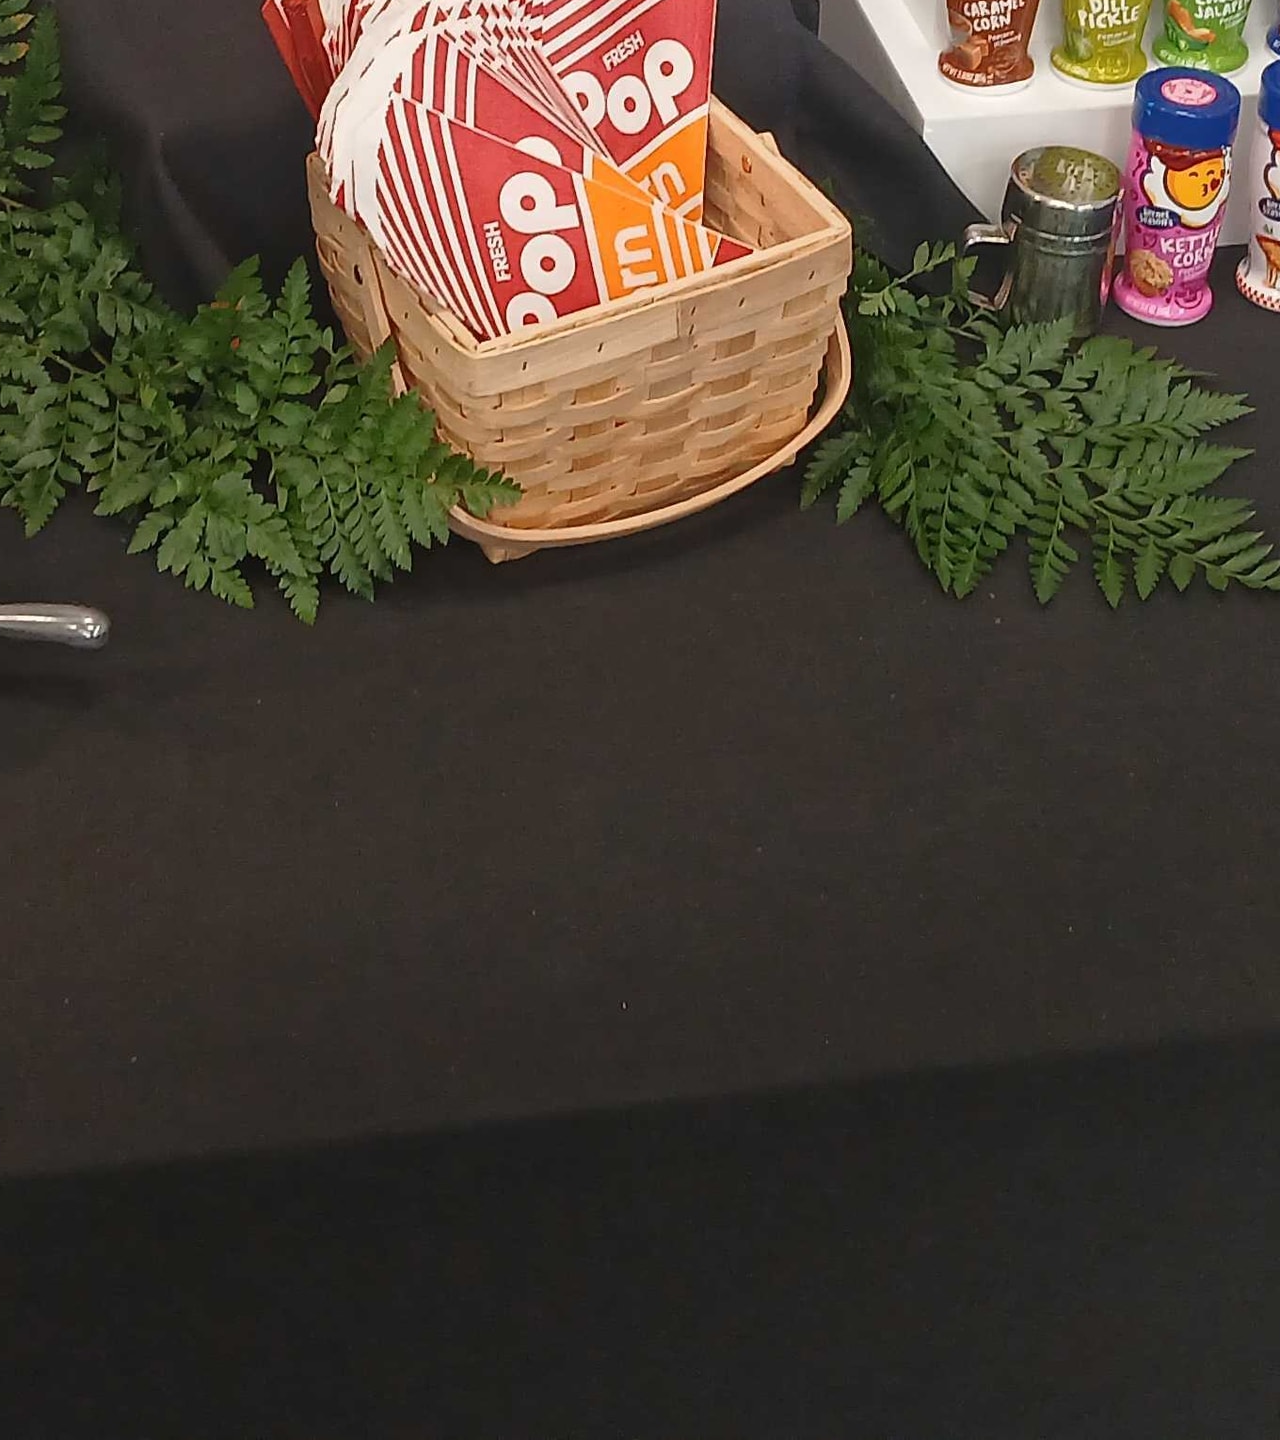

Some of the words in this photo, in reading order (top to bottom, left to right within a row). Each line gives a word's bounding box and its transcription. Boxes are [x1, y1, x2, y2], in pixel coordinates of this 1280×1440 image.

[973, 10, 1011, 32] CORN
[1077, 5, 1141, 29] PICKLE
[602, 30, 644, 71] FRESH
[483, 221, 512, 283] FRESH
